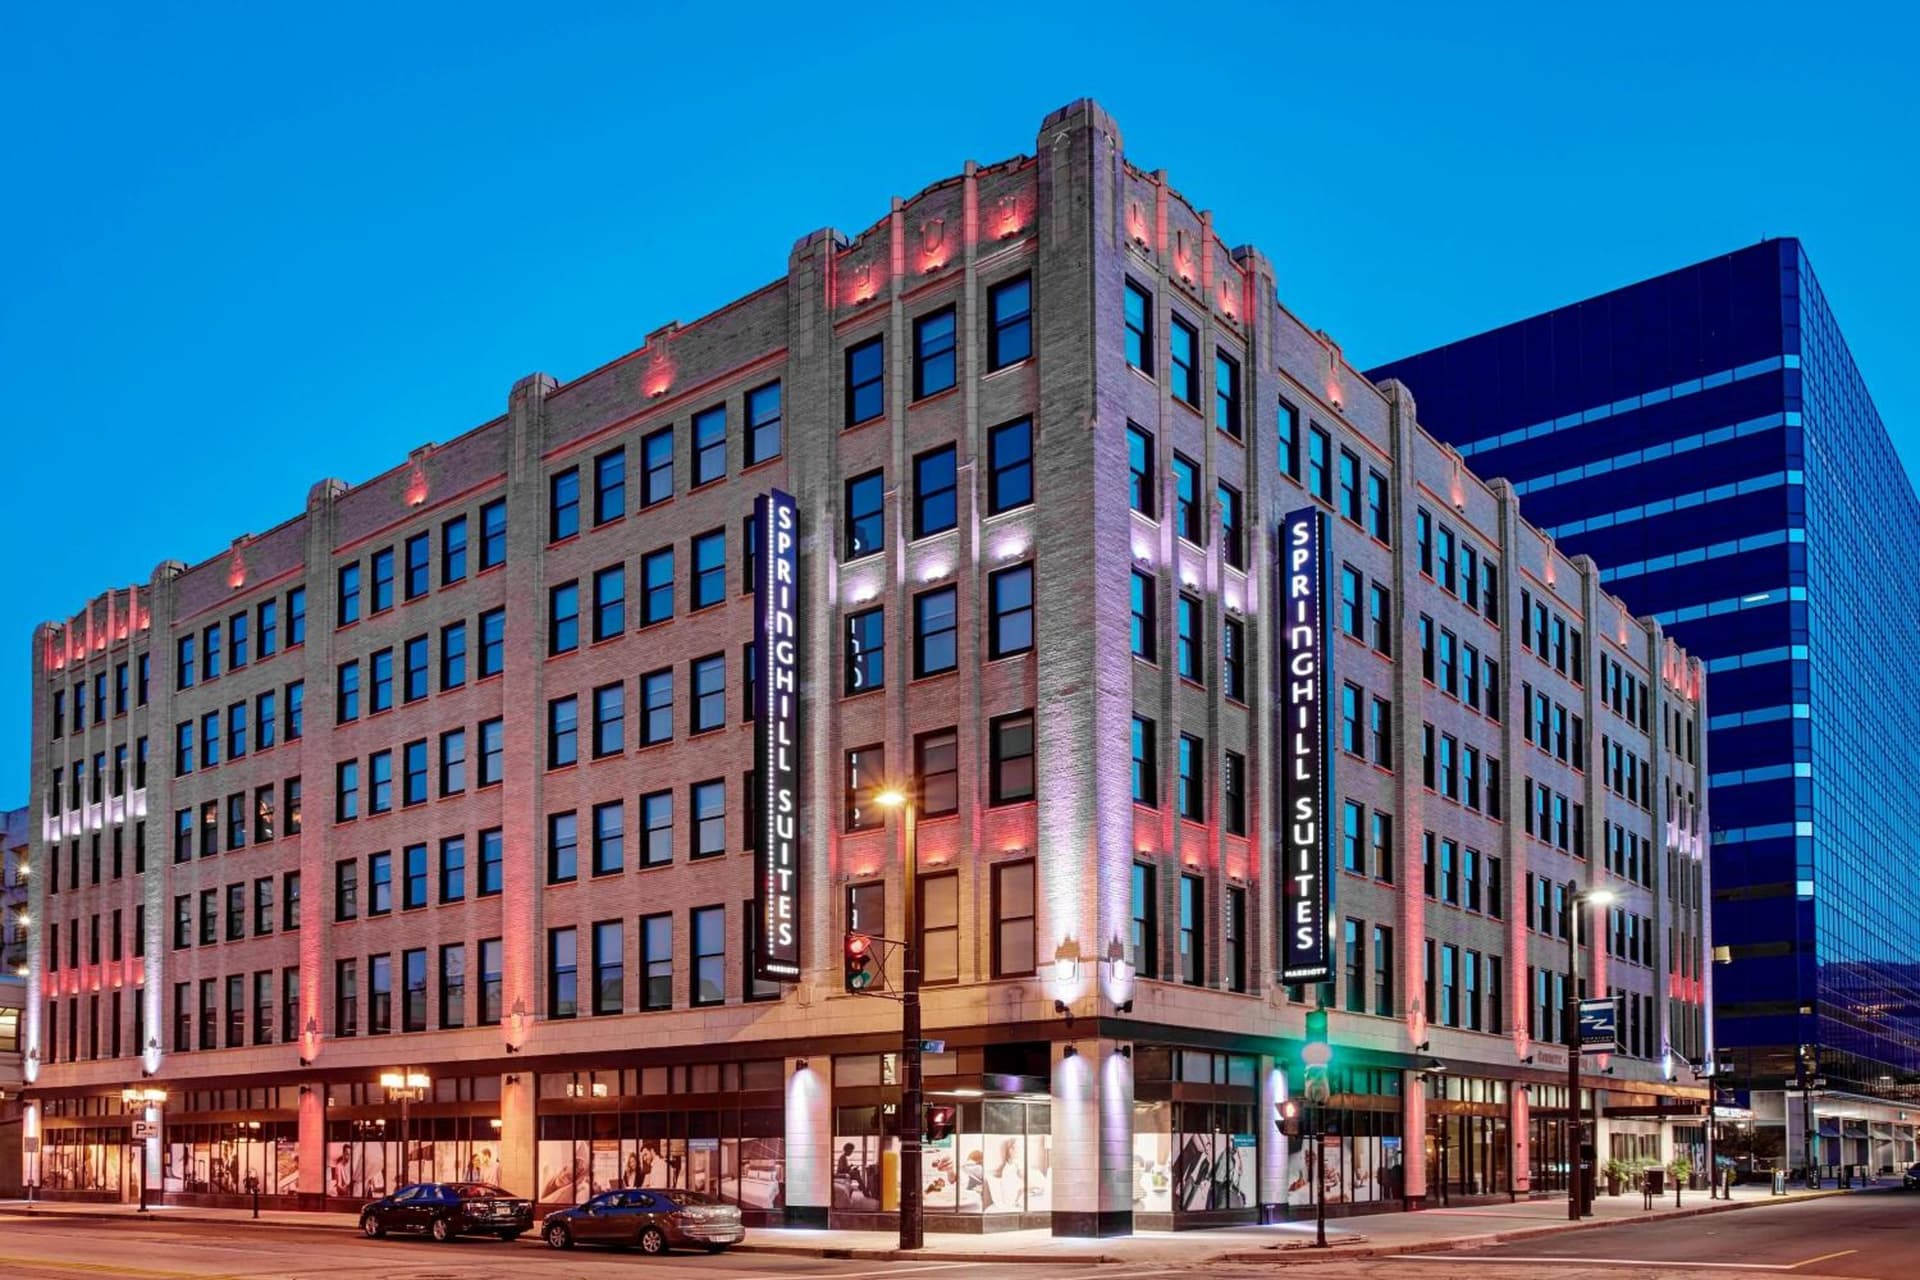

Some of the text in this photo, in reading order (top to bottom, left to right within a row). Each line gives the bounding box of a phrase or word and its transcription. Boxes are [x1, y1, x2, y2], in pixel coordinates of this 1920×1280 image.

[776, 505, 794, 946] SPRINGHILL SUITES
[1291, 521, 1315, 950] SPRINGHILL SUITES
